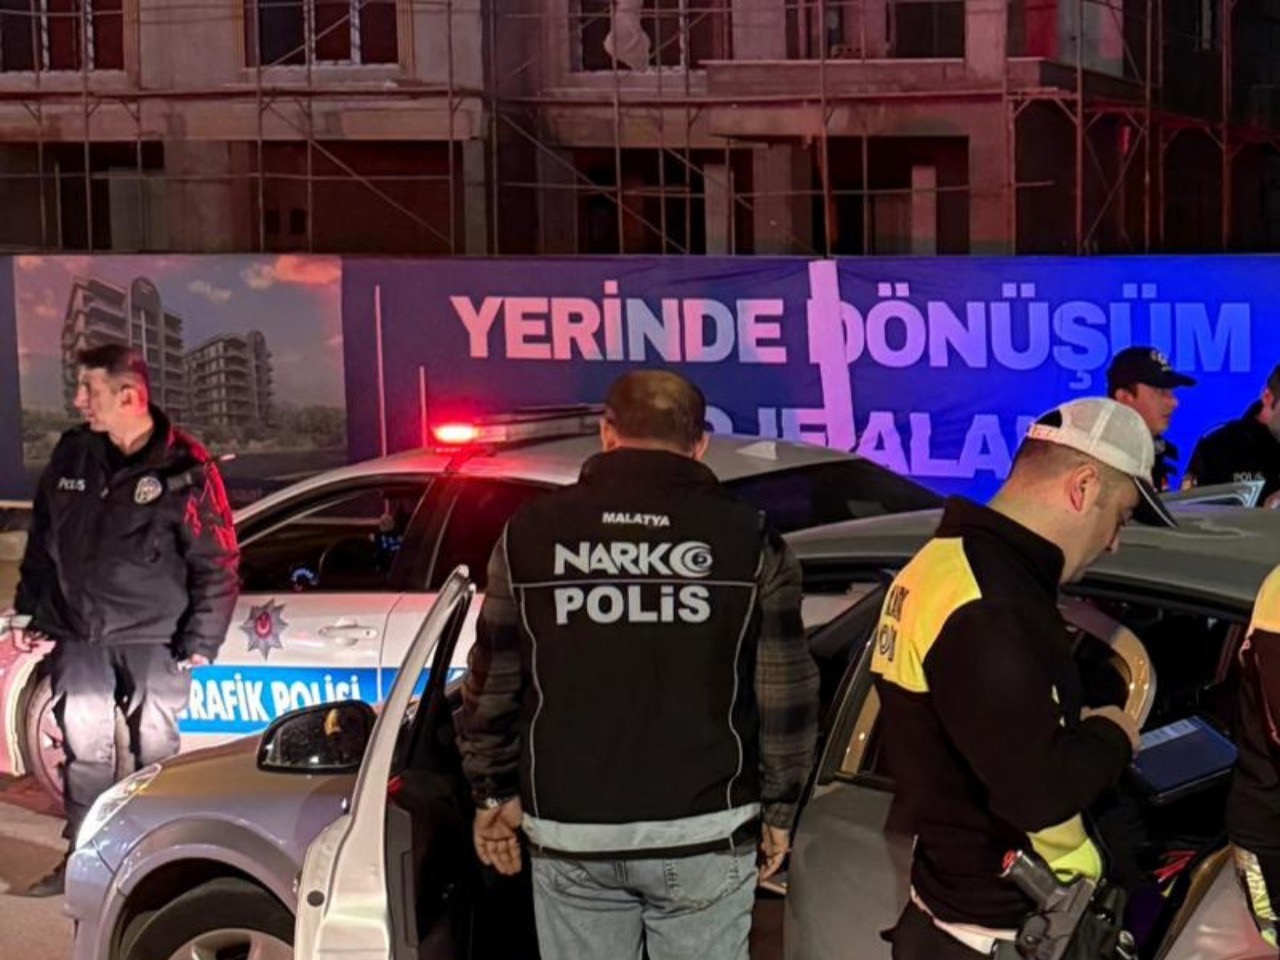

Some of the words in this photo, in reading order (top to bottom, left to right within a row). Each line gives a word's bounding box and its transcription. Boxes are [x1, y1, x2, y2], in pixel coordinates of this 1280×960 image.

[450, 280, 787, 363] YERİNDE
[807, 283, 1250, 389] DÖNÜŞÜM
[602, 512, 671, 527] MALATYA
[178, 673, 270, 722] RAFİK
